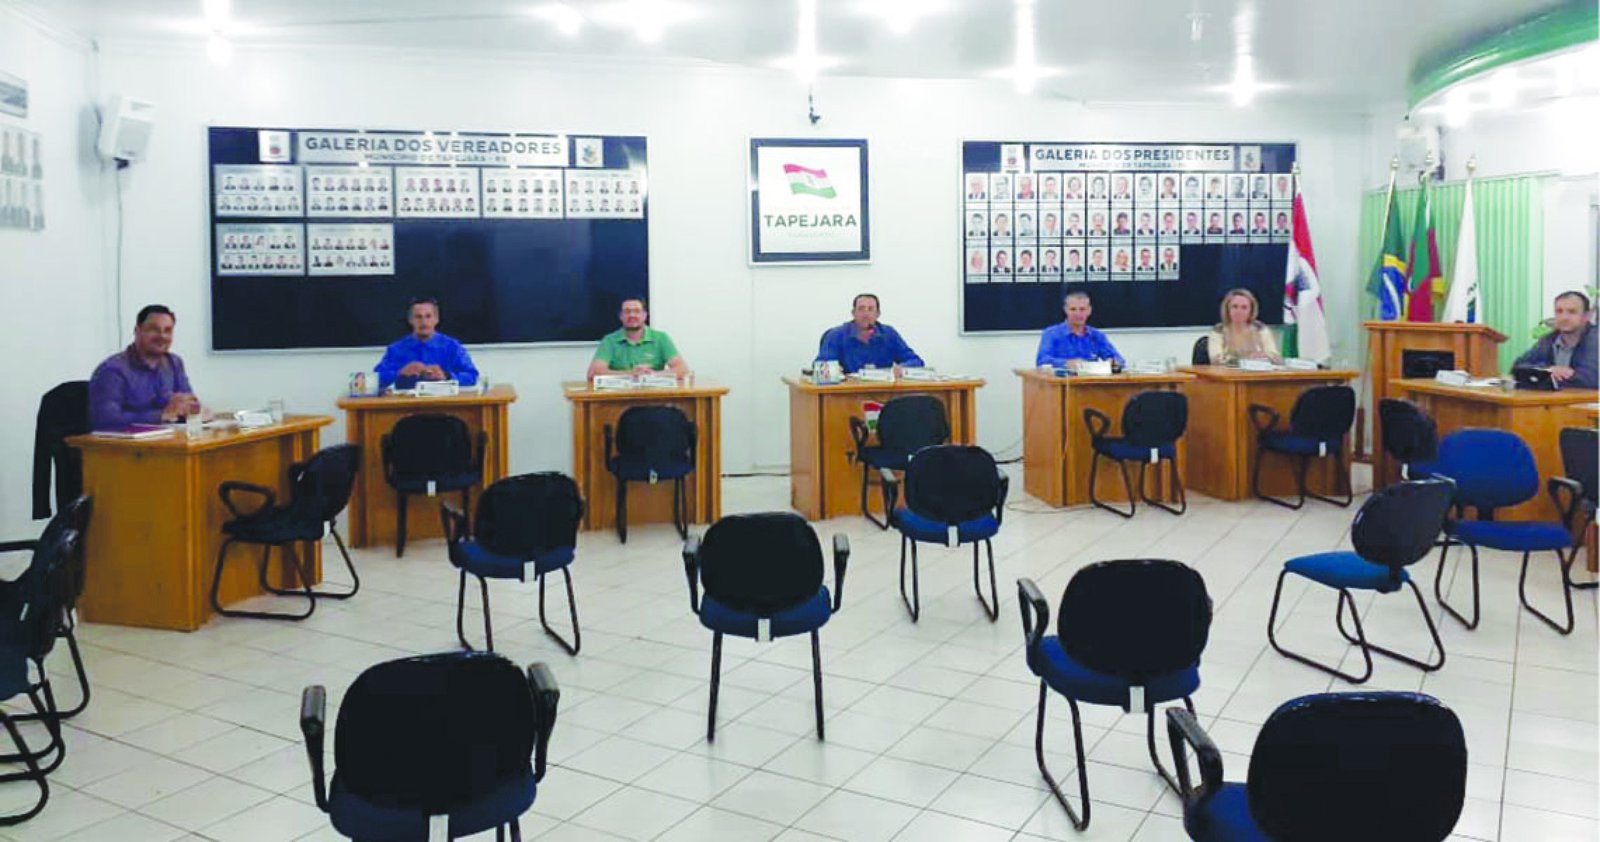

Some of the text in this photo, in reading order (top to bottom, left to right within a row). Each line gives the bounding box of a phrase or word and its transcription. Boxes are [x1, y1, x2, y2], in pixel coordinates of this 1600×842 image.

[305, 137, 561, 154] GALERIA DOS VEREADORES
[1035, 149, 1230, 161] GALERIA DOS PRESIDENTES
[764, 214, 857, 227] TAPEJARA
